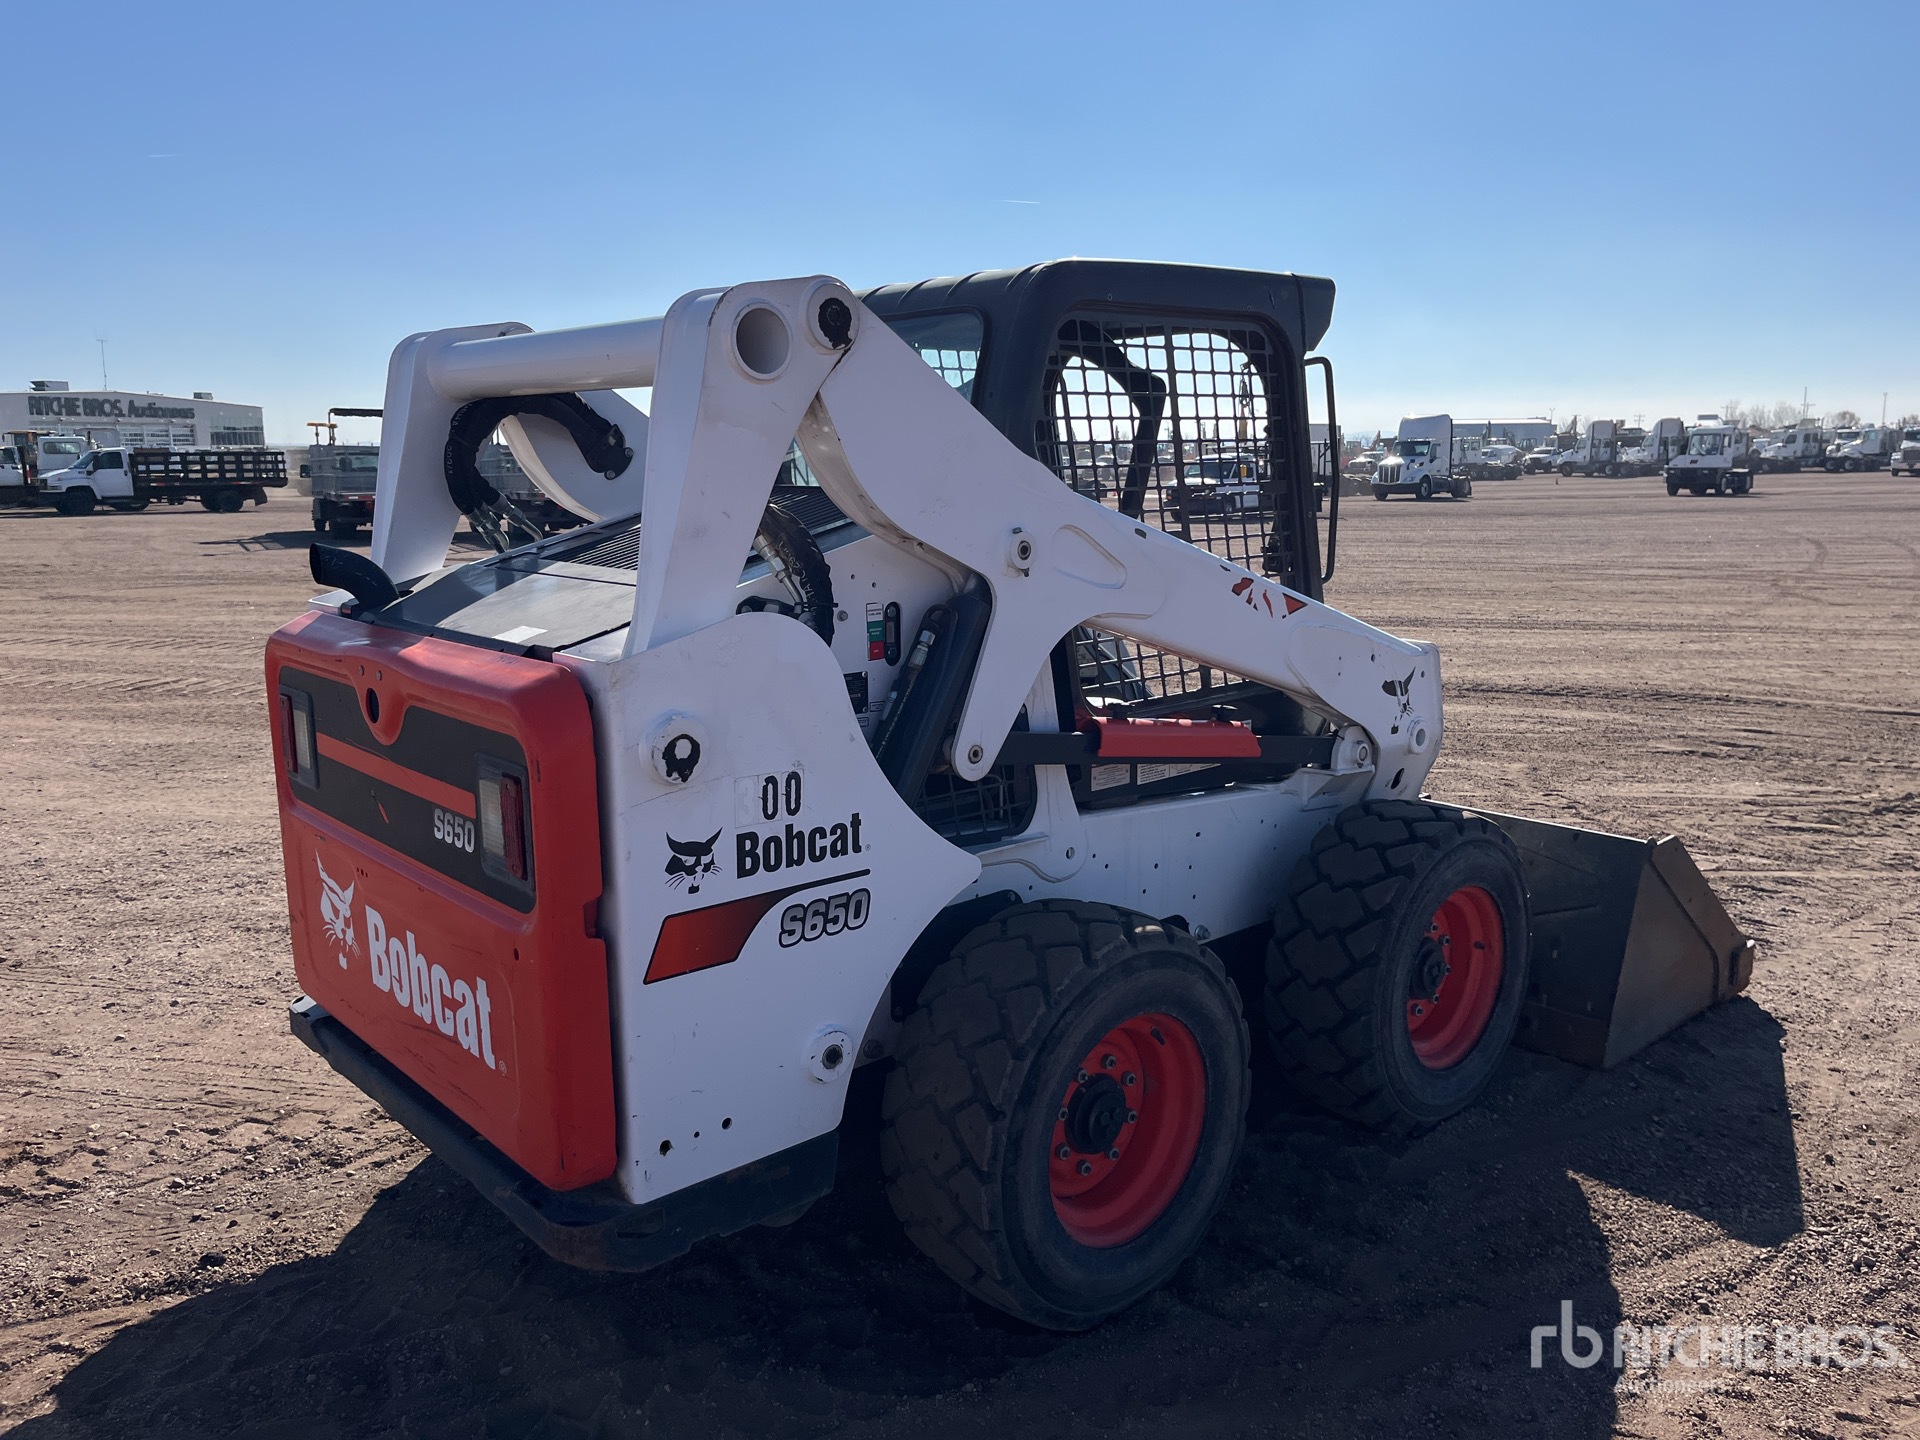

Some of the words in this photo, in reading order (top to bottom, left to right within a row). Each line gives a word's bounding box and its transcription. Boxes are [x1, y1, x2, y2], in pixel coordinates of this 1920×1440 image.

[434, 808, 475, 853] S650
[736, 812, 862, 879] Bobcat
[779, 887, 871, 948] S650
[365, 904, 496, 1070] Bobcat
